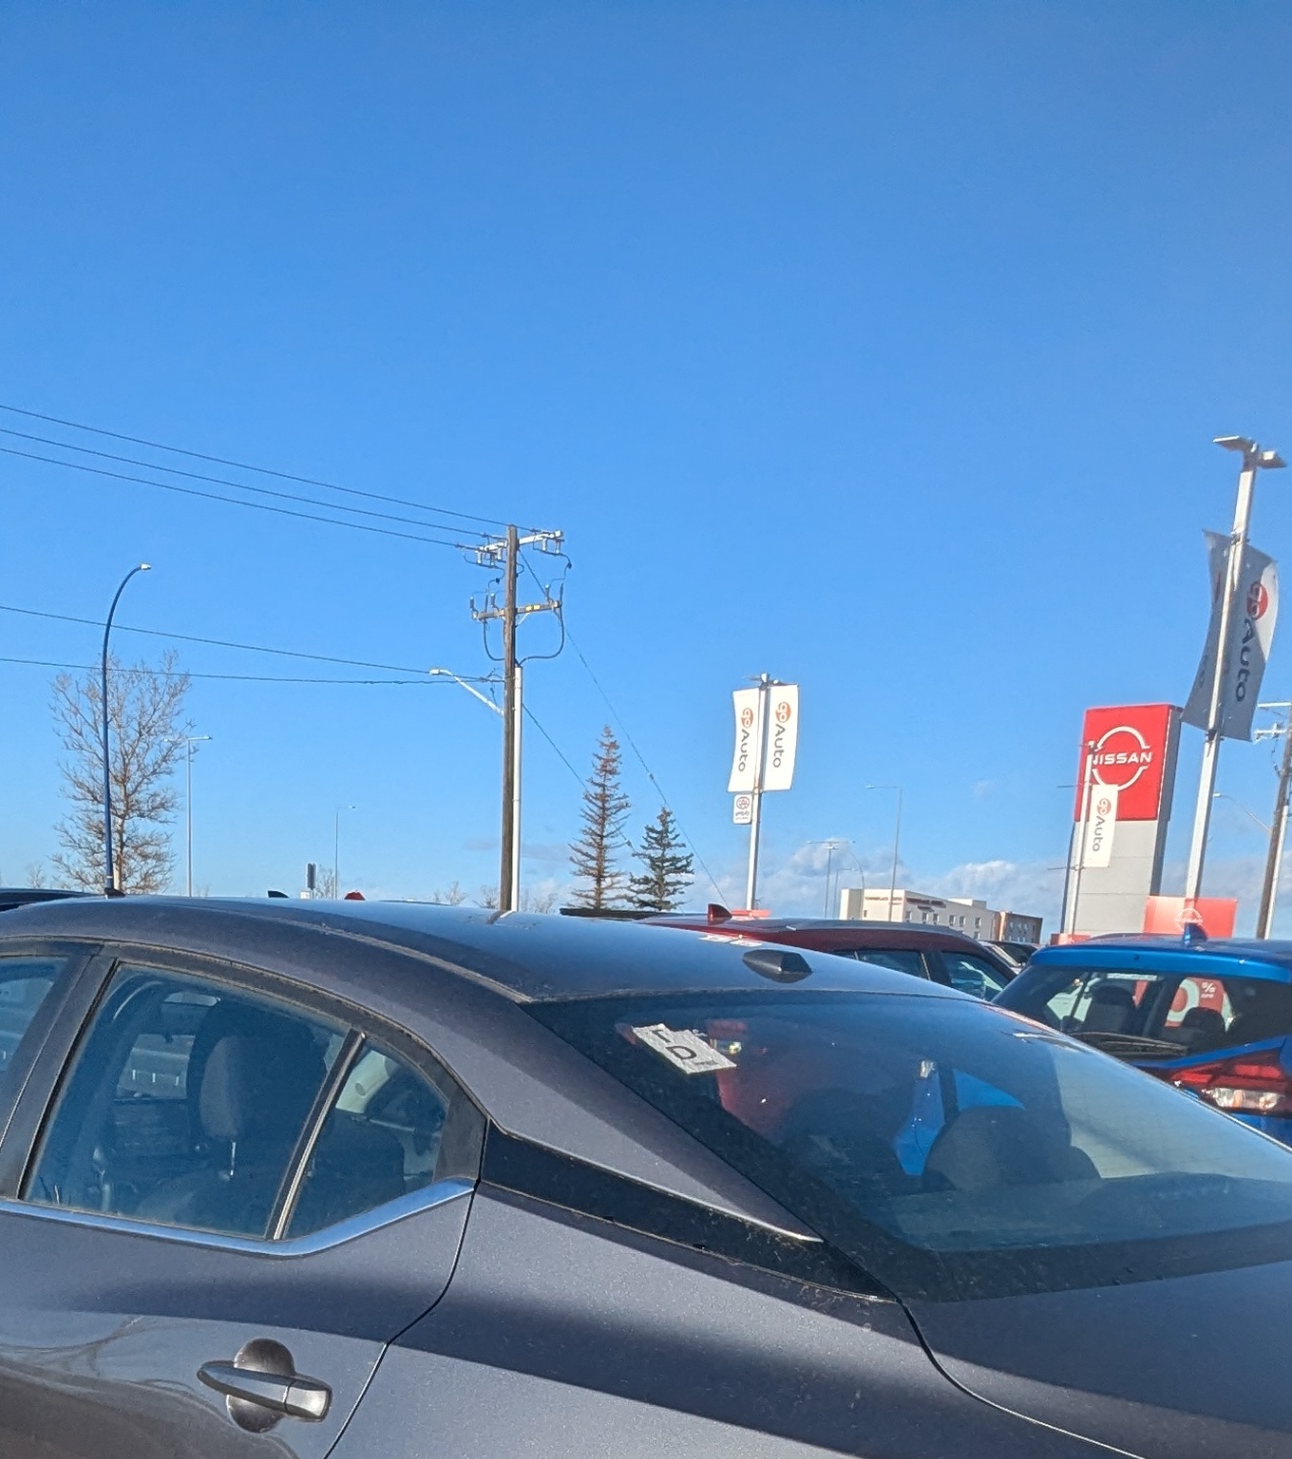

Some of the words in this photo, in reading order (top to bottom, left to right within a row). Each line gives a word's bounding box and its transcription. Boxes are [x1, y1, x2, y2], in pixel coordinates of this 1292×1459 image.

[1236, 618, 1254, 702] Auto
[738, 729, 750, 772] Auto
[772, 723, 787, 768] Auto
[1092, 752, 1152, 766] NISSAN
[1092, 815, 1105, 852] Auto
